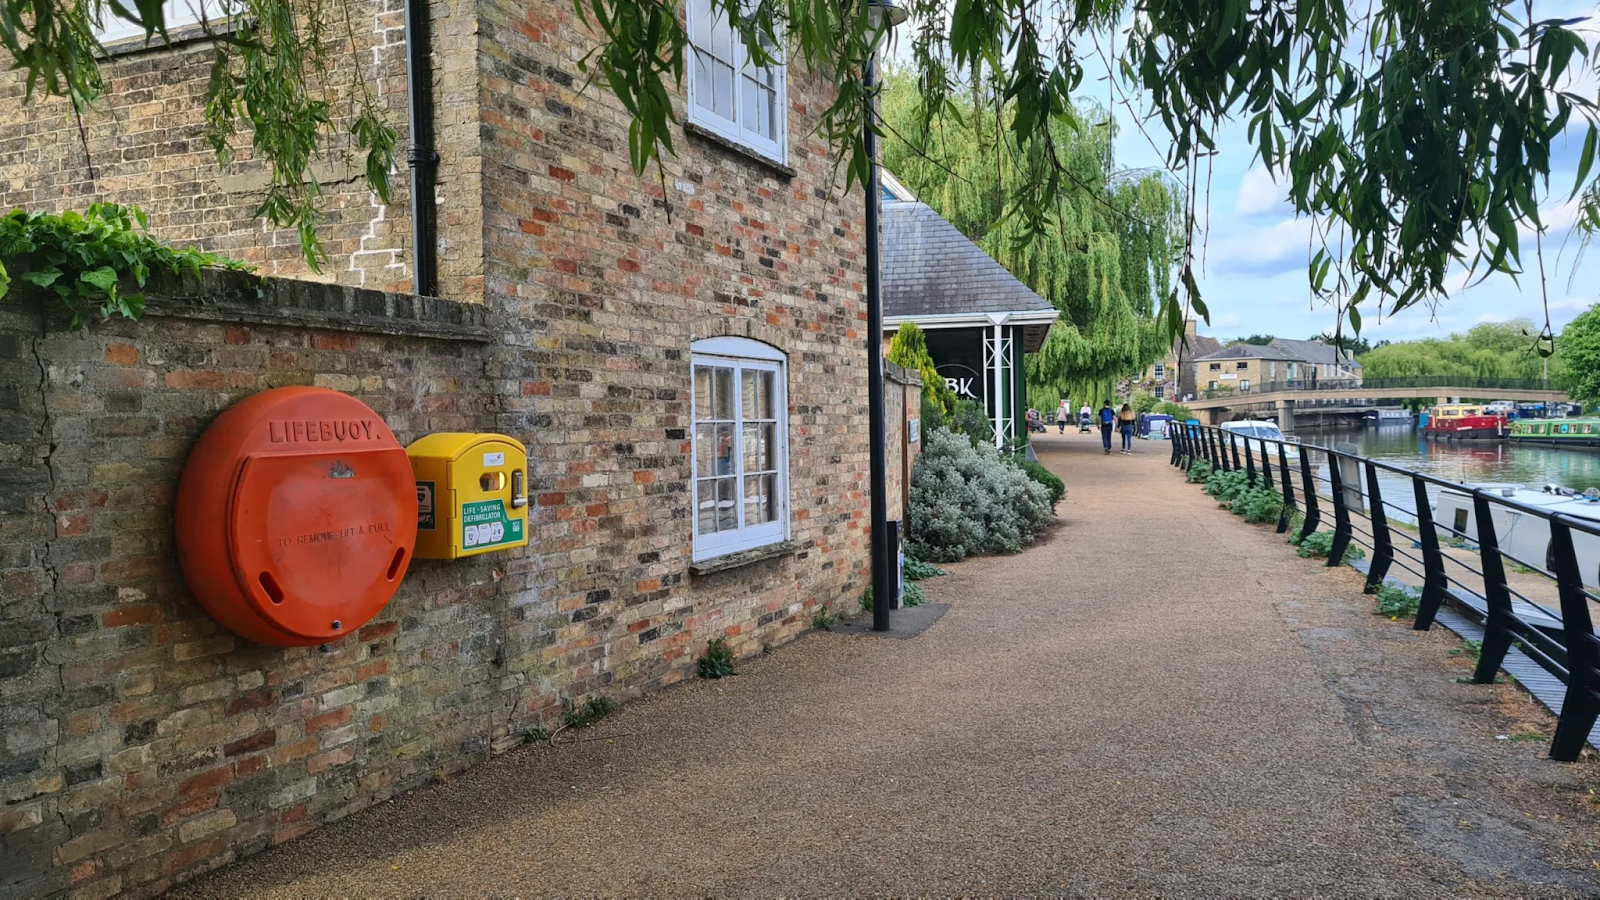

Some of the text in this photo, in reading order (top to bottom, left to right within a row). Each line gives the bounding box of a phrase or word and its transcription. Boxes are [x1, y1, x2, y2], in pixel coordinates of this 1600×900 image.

[463, 507, 476, 515] LIFE
[480, 504, 501, 513] SAVING
[463, 512, 501, 523] DEFIBRILLATOR
[278, 537, 292, 547] TO
[340, 527, 355, 538] LIFT
[359, 525, 364, 535] &
[369, 522, 392, 533] PULL
